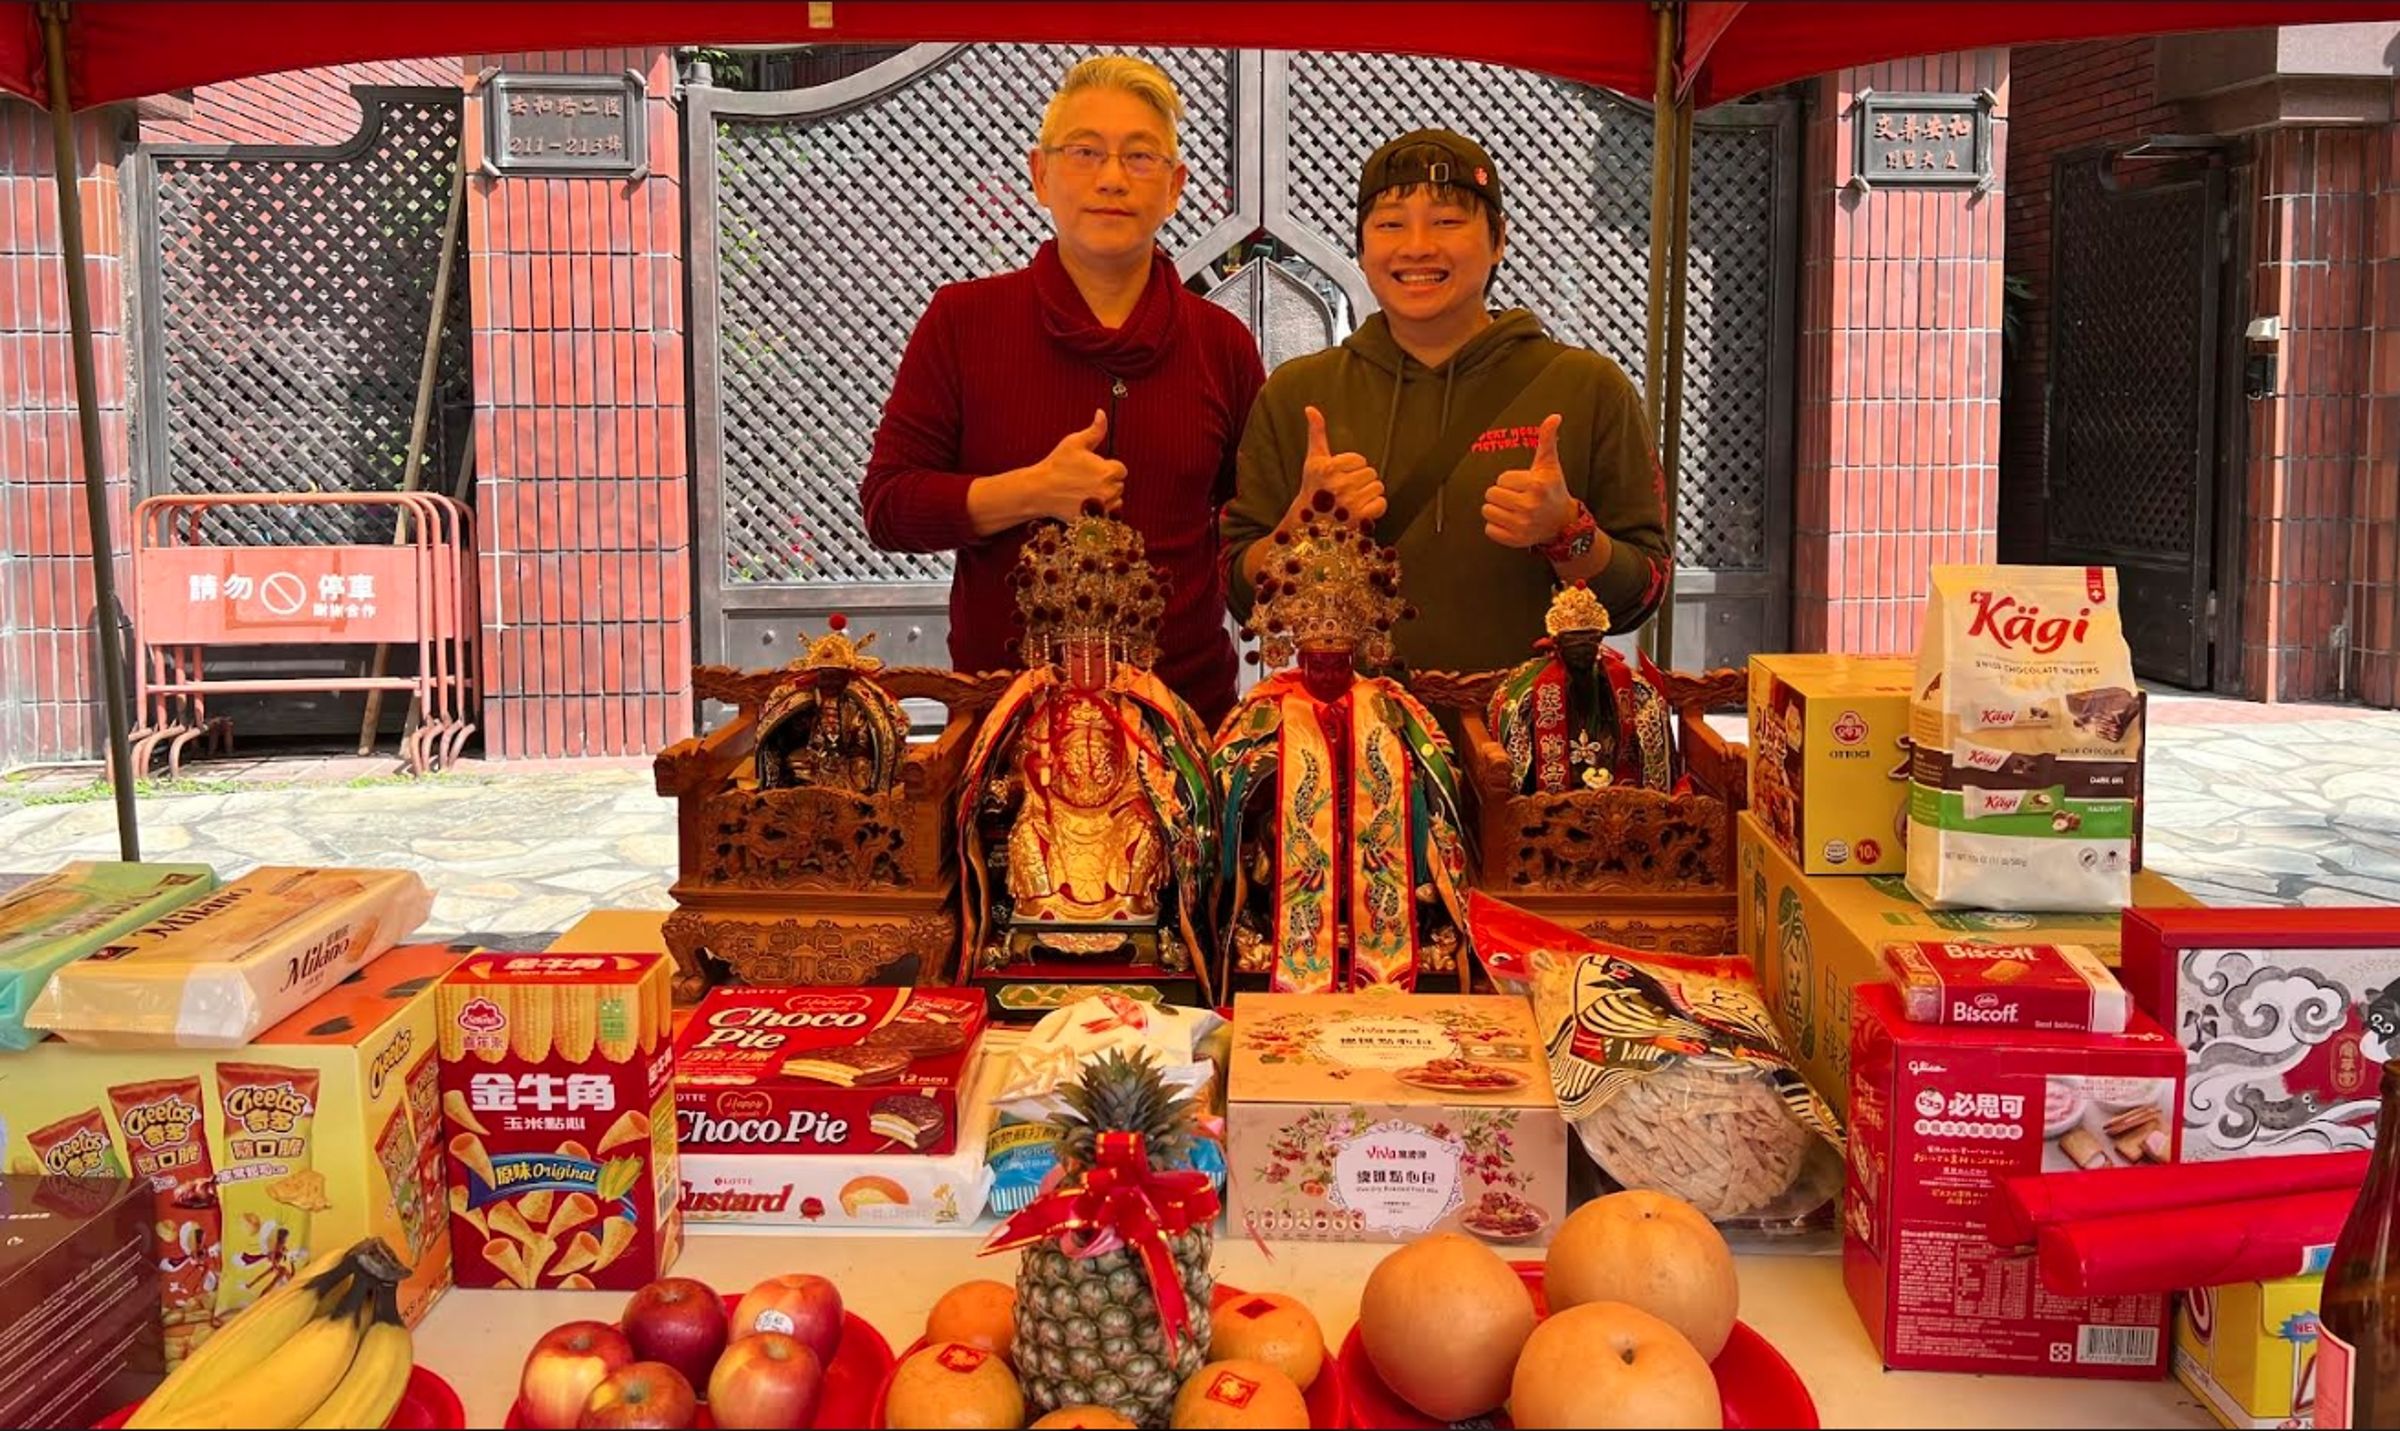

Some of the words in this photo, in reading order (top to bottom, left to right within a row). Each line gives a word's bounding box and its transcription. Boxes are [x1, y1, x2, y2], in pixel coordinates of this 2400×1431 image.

[508, 96, 621, 118] 安和路二段
[189, 574, 253, 601] 請勿
[317, 574, 376, 601] 停車
[312, 604, 376, 618] 謝謝合作
[1968, 590, 2090, 654] Kägi
[2004, 664, 2058, 675] CHOCOLATE
[1981, 708, 2016, 723] Kägi
[1828, 750, 1871, 759] OTTOGI
[1968, 750, 2001, 767] Kägi
[2082, 747, 2125, 756] CHOCOLATE
[1984, 797, 2019, 811] Kägi
[132, 887, 253, 940] Milano
[1944, 944, 2041, 961] Biscoff
[280, 938, 350, 992] Milano
[708, 1007, 867, 1028] Choco
[1953, 1002, 2019, 1023] Biscoff
[692, 1028, 786, 1048] Pie
[227, 1085, 308, 1117] Cheetos
[470, 1072, 616, 1111] 金牛角
[676, 1093, 707, 1102] OTTE
[125, 1098, 195, 1136] Cheetos
[1948, 1092, 2025, 1120] 必思可
[246, 1108, 294, 1133] 奇多
[503, 1116, 586, 1131] 玉米點心
[143, 1122, 187, 1146] 奇多
[48, 1131, 103, 1171] Cheetos
[496, 1162, 532, 1186] 原味
[532, 1161, 597, 1183] Original
